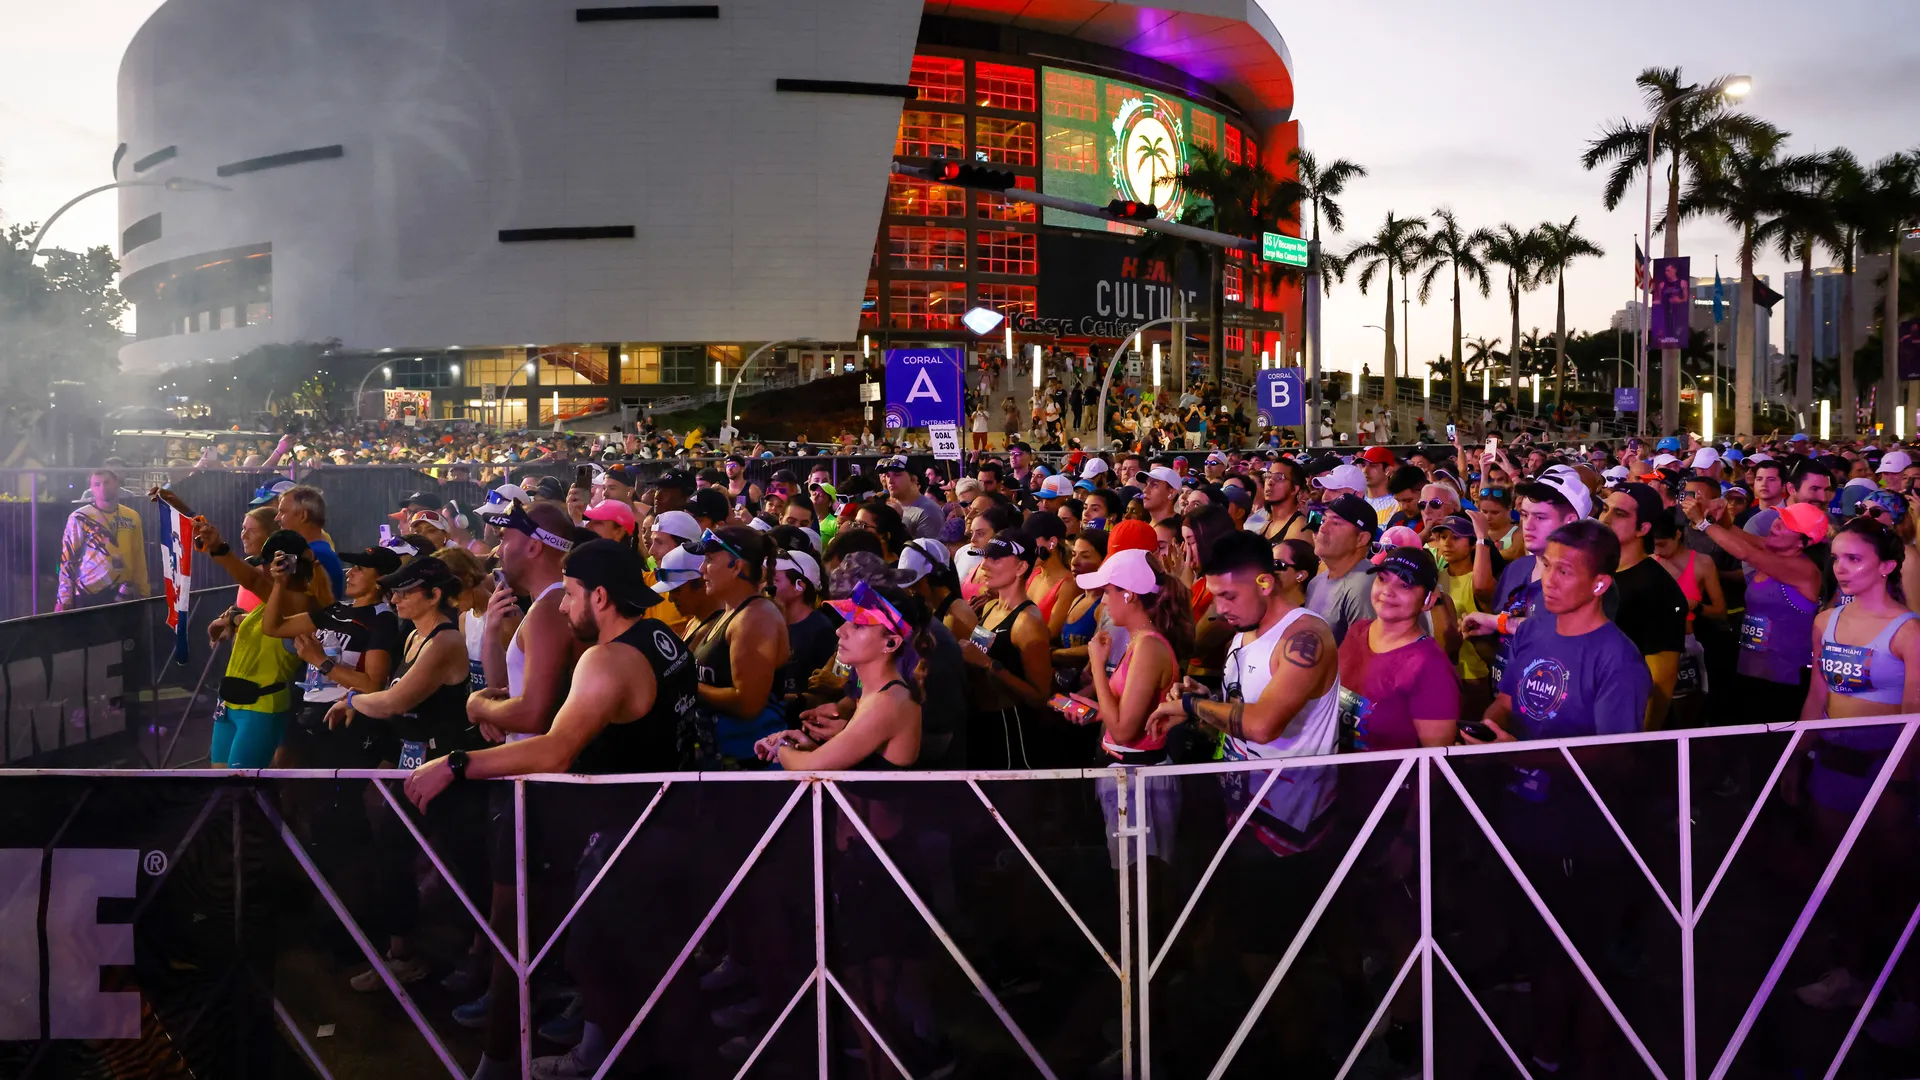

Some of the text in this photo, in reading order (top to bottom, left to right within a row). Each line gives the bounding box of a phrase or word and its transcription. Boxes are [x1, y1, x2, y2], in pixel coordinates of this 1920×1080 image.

[1009, 312, 1076, 340] Kaseya
[903, 356, 943, 364] CORRAL
[905, 366, 942, 403] A
[1271, 381, 1290, 407] B
[939, 442, 955, 450] 2:30
[543, 534, 570, 549] WOLVES
[1843, 648, 1862, 656] MIAMI
[1821, 658, 1863, 677] 18283
[1526, 678, 1557, 697] MIAMI
[1346, 695, 1364, 708] MIAMI
